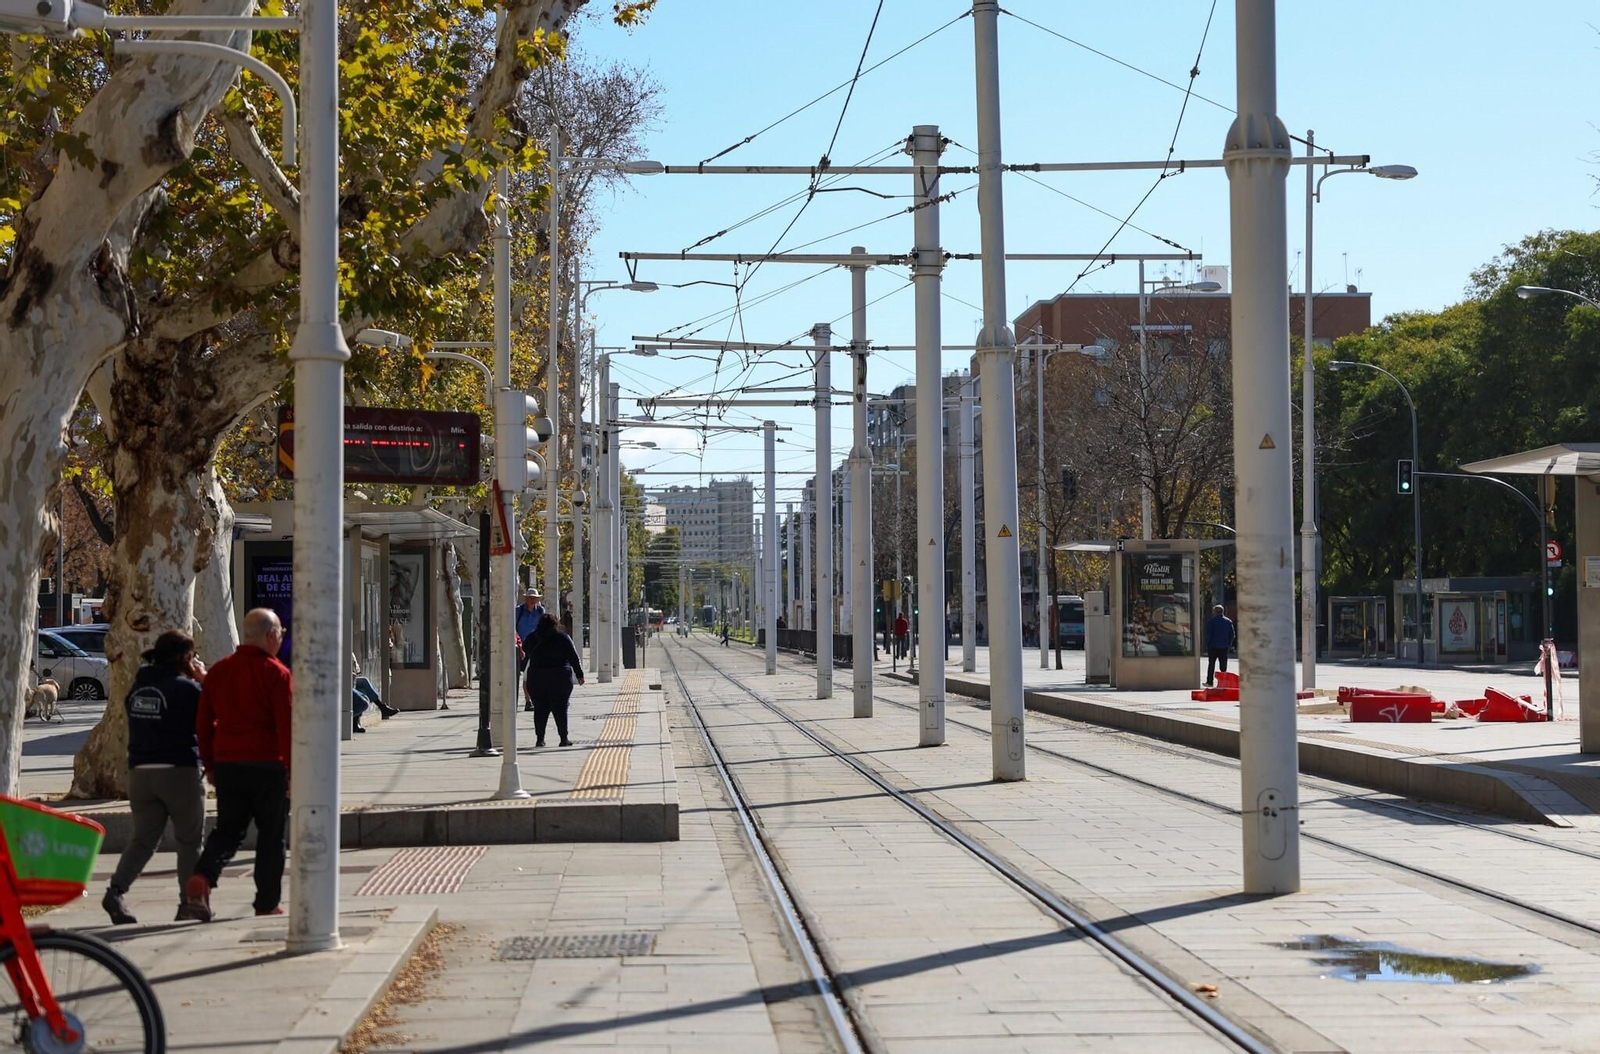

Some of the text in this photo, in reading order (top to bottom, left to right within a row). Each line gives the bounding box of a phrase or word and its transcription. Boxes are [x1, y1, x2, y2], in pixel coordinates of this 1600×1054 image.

[1116, 542, 1124, 550] H
[1144, 564, 1170, 574] Rustik
[266, 583, 292, 591] DE SE
